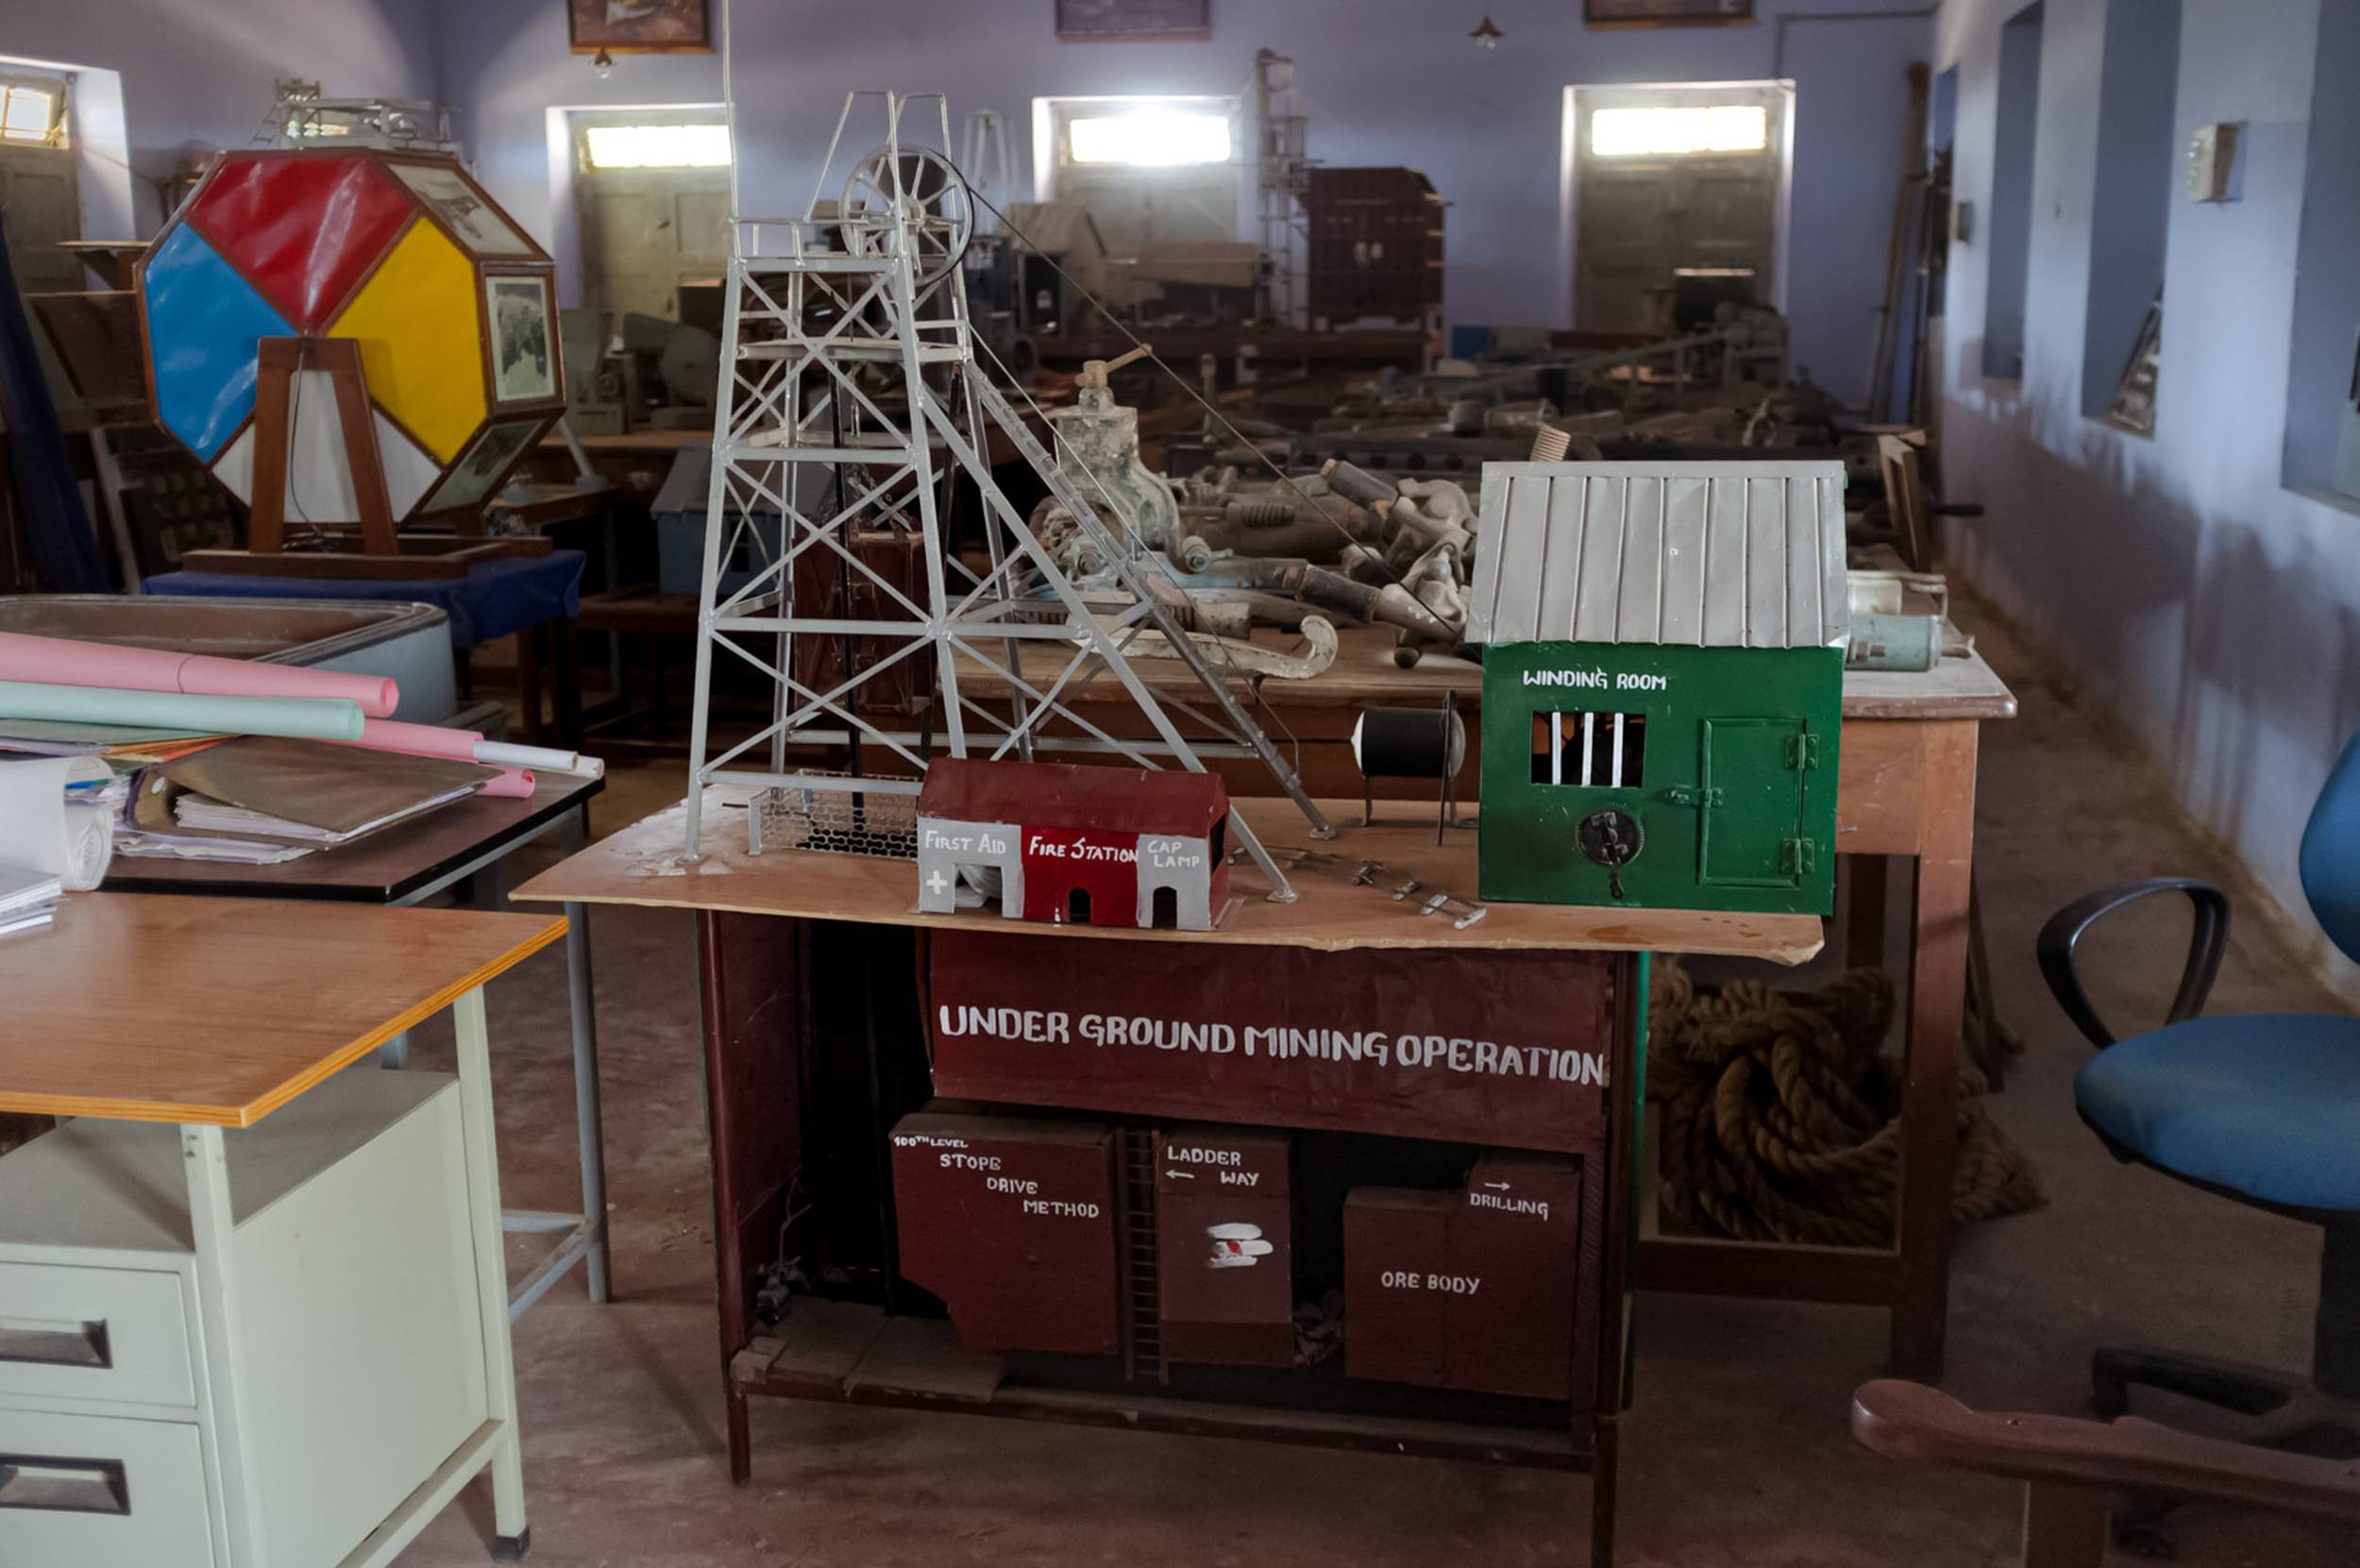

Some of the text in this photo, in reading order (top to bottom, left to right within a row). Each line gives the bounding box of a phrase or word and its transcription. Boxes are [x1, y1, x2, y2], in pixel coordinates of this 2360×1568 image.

[1523, 668, 1666, 690] WINDING ROOM
[924, 830, 1006, 854] FIRST AID
[1029, 836, 1138, 863] FIRE STATION
[1147, 840, 1182, 853] CAP
[1154, 855, 1200, 868] LAMP
[939, 1004, 1604, 1087] UNDER GROUND MINING OPERATION
[930, 1138, 969, 1149] LEVEL
[940, 1154, 1002, 1171] STOPE
[1167, 1146, 1241, 1166] LADDER
[986, 1178, 1038, 1194] DRIVE
[1221, 1172, 1259, 1187] WAY
[1023, 1200, 1100, 1218] METHOD
[1470, 1193, 1549, 1221] DRILLING
[1381, 1272, 1480, 1294] ORE BODY
